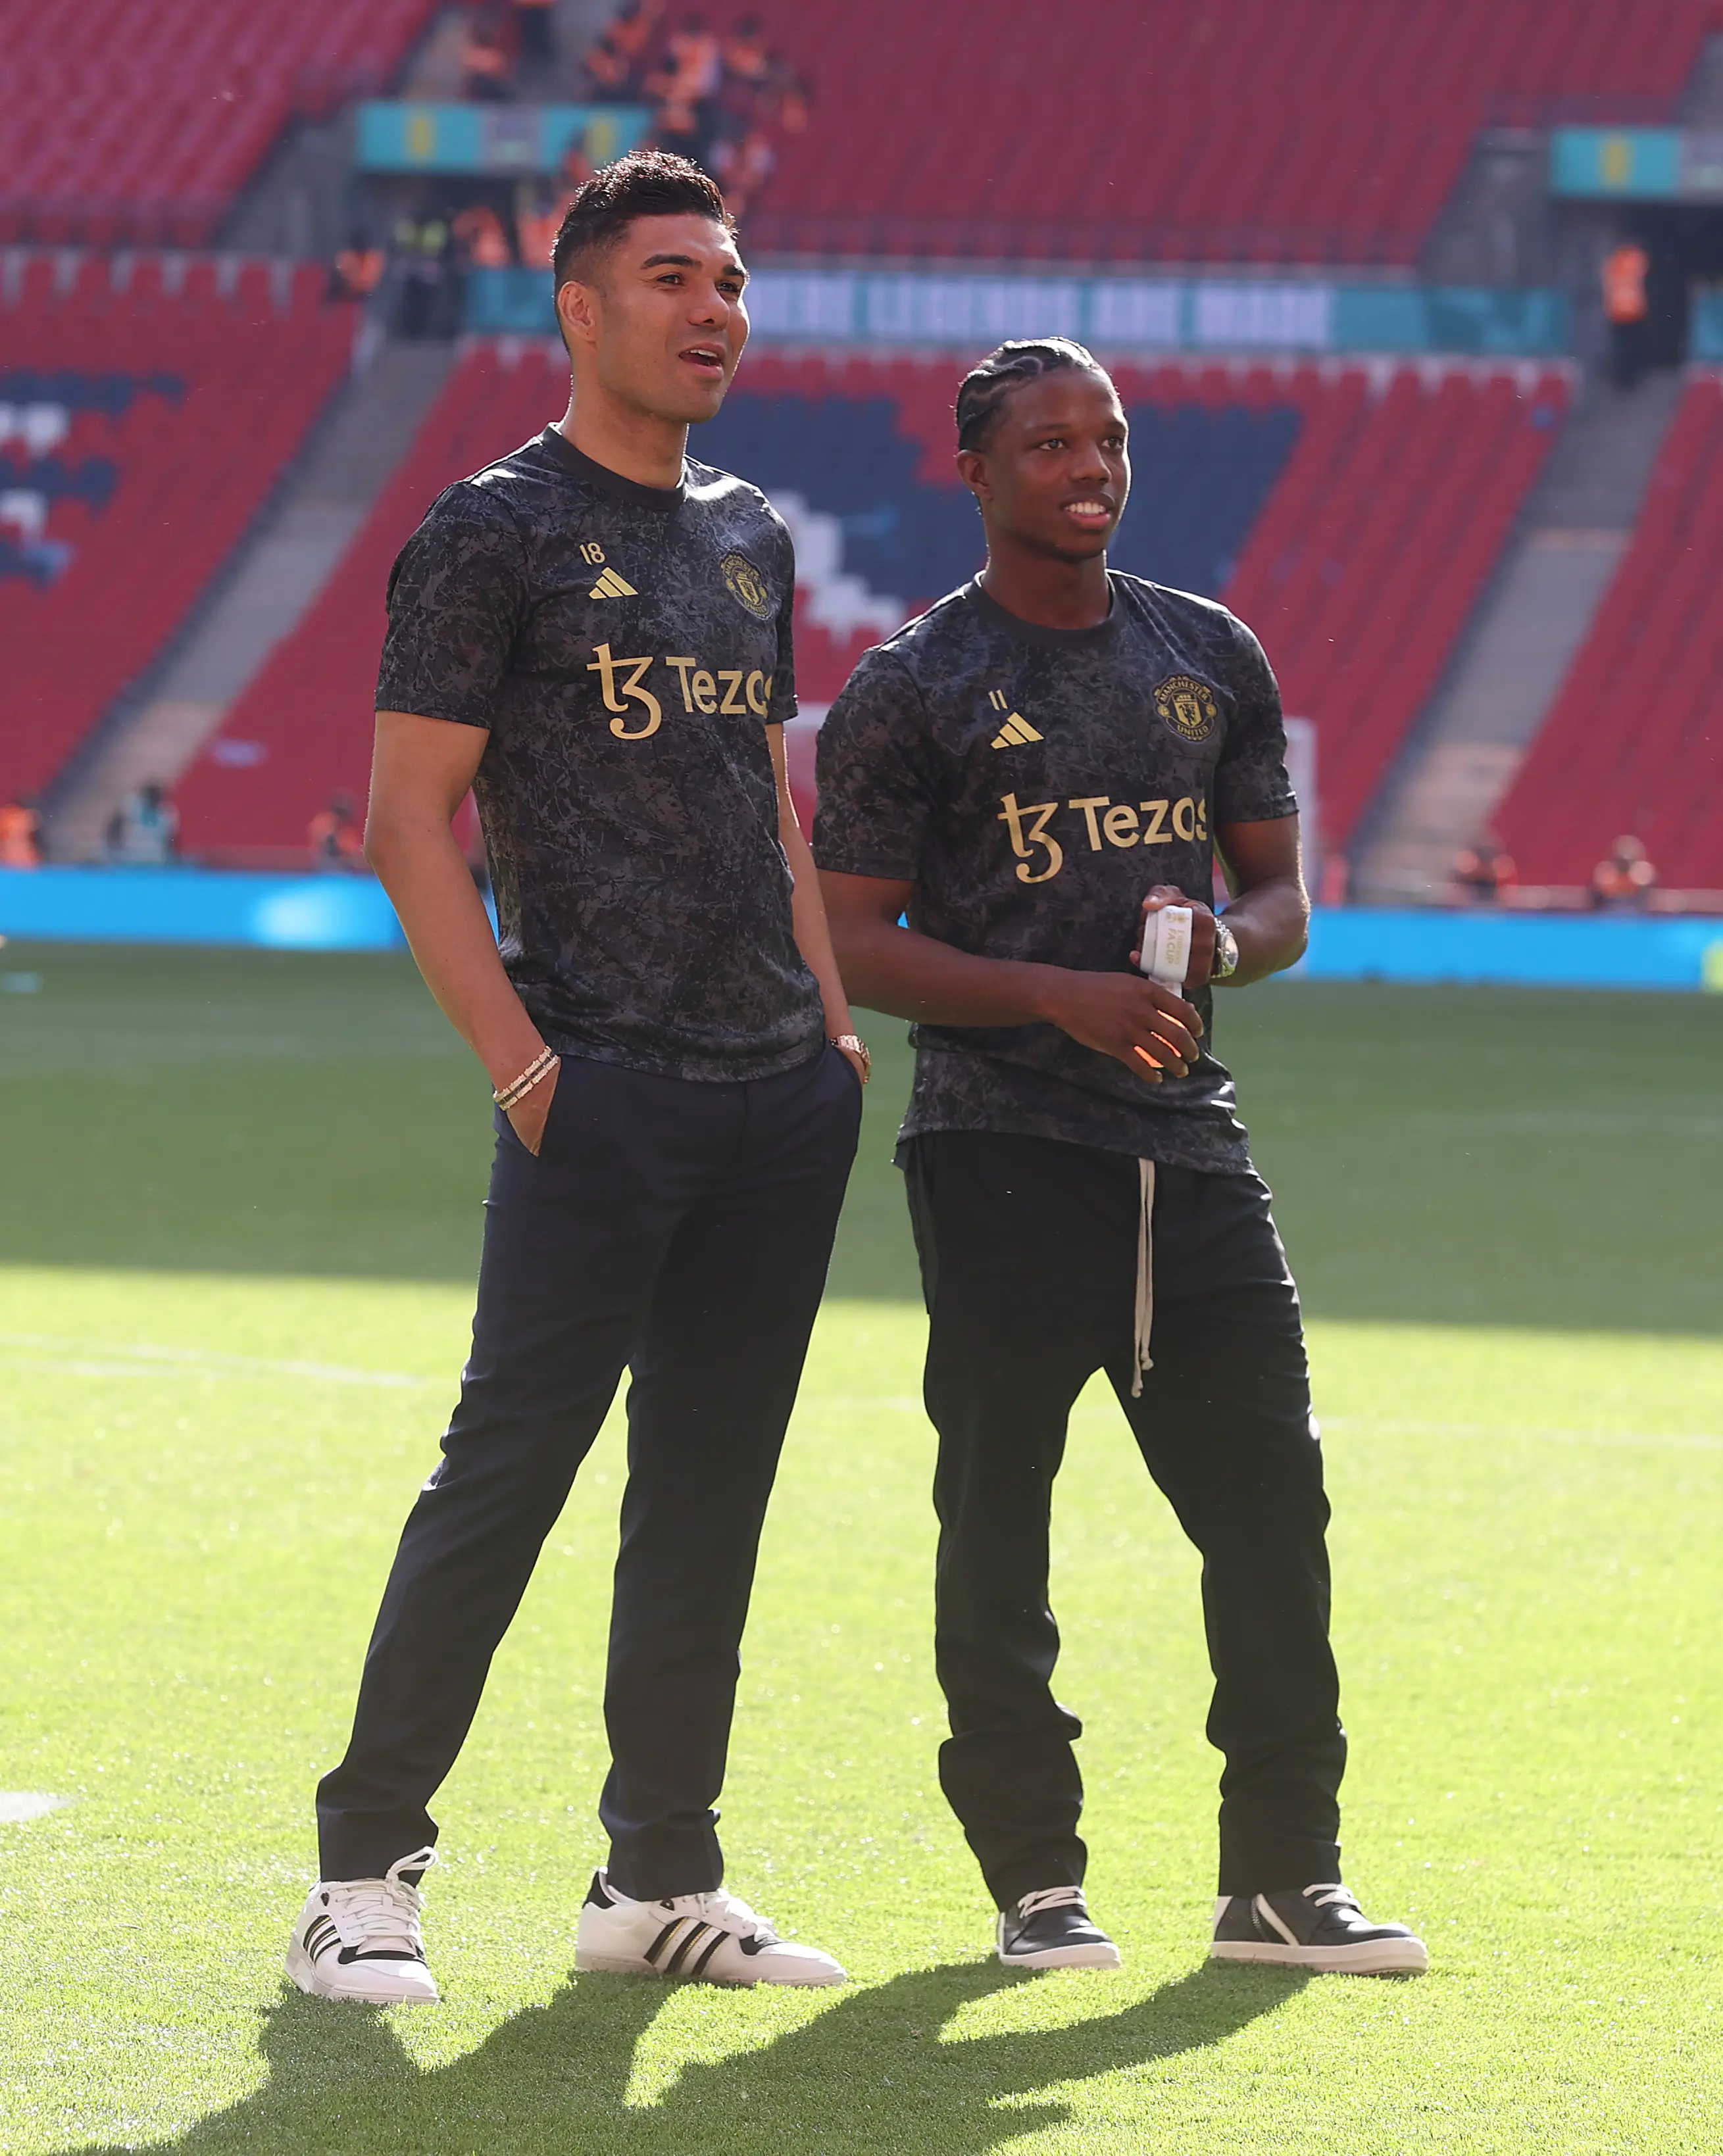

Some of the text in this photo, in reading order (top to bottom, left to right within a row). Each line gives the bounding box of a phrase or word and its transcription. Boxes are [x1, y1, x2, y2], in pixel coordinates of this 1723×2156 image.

[579, 543, 605, 565] 18
[988, 689, 1008, 710] 11
[1160, 681, 1209, 702] MANCHESTER
[1177, 724, 1209, 737] UNITED
